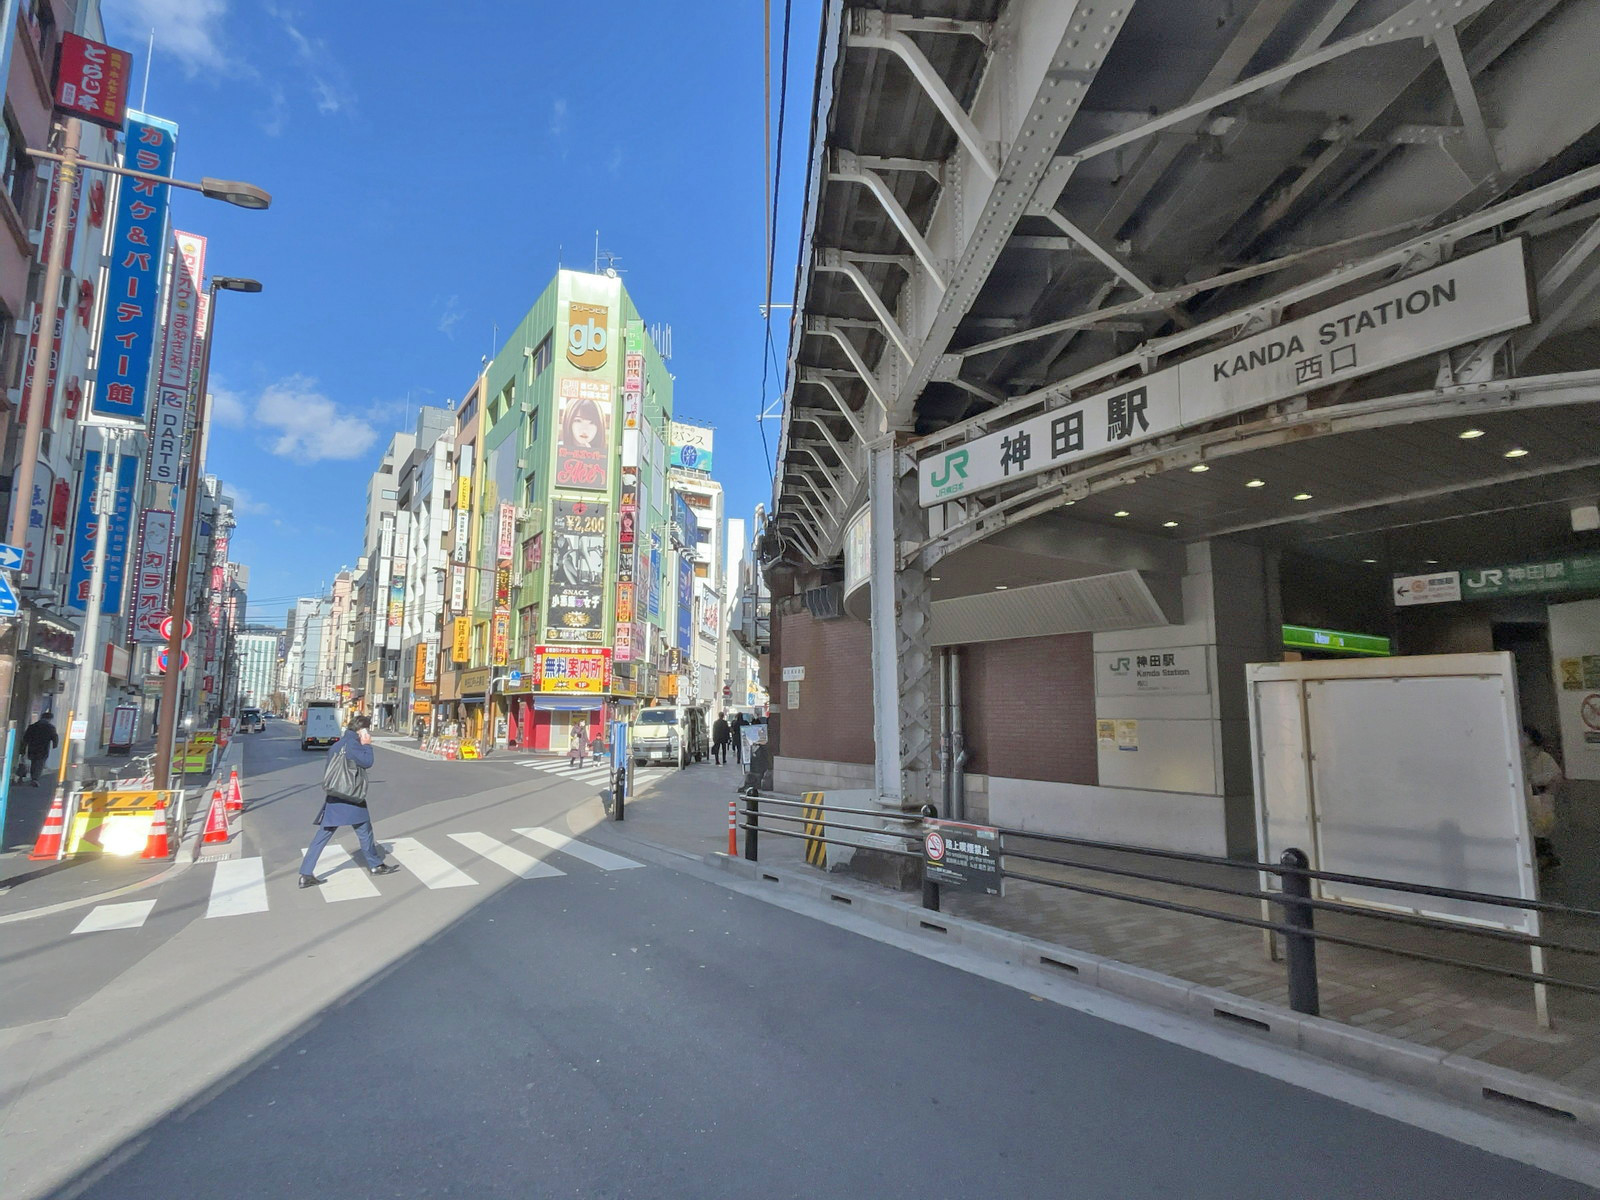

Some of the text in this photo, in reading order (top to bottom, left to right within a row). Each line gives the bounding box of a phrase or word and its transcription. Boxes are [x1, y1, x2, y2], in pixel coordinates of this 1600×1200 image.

[107, 126, 164, 406] カラオケ&パーティー館
[569, 318, 607, 356] gb
[1213, 278, 1457, 383] KANDA STATION
[1294, 344, 1358, 387] 西口
[157, 414, 177, 478] DARTS
[1000, 387, 1150, 476] 神田駅
[931, 449, 969, 487] JR
[566, 515, 605, 534] ¥2,200
[1467, 569, 1503, 588] JR
[544, 657, 602, 678] 無料案内所
[1110, 657, 1130, 671] JR
[1136, 654, 1175, 668] 神田駅
[1136, 669, 1190, 678] Kanda Station
